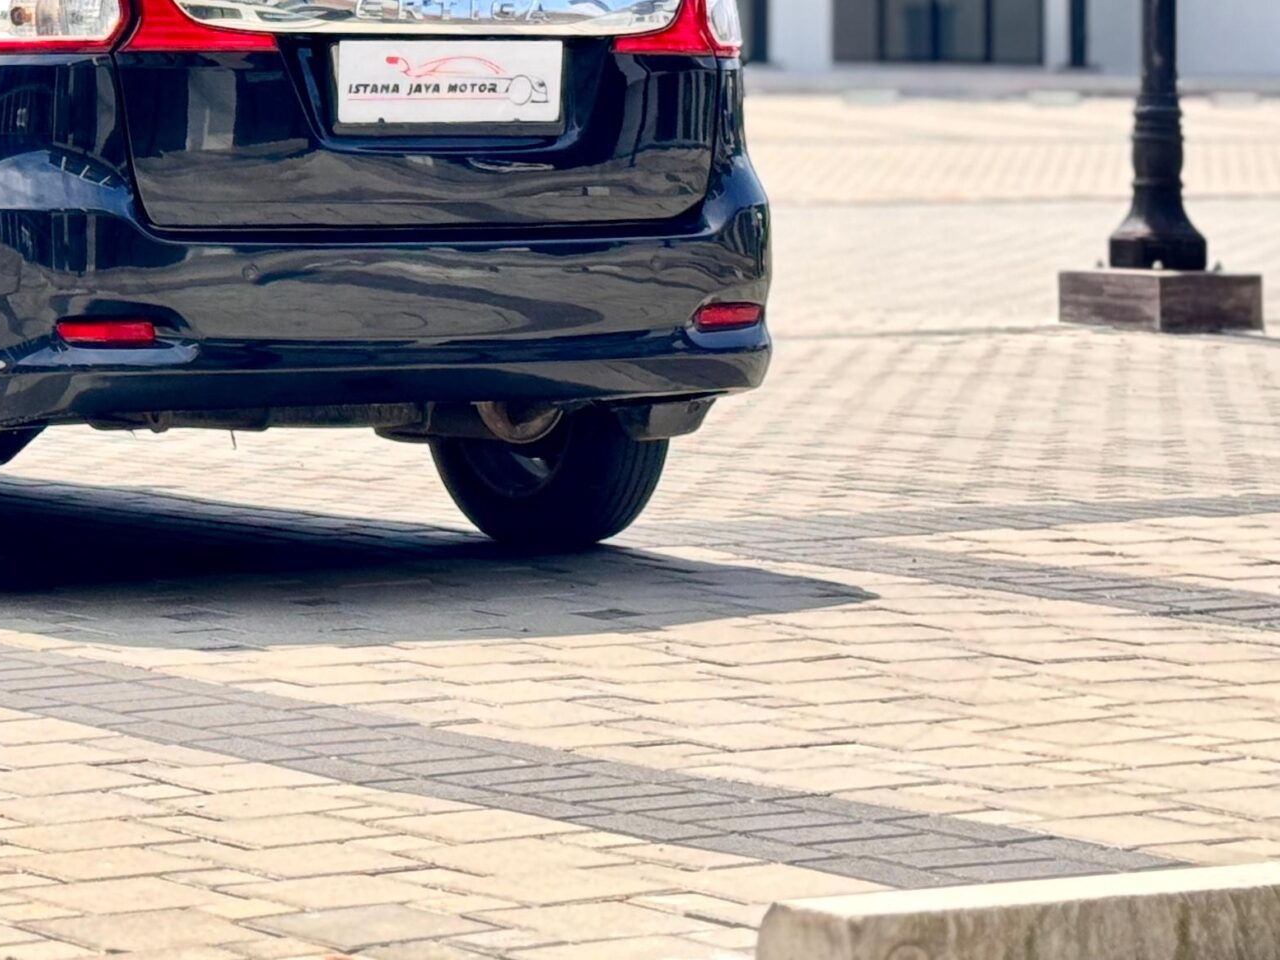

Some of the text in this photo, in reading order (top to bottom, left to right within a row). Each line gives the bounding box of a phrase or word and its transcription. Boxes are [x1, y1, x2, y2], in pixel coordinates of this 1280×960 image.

[348, 83, 498, 96] ISTANA JAYA MOTOR
